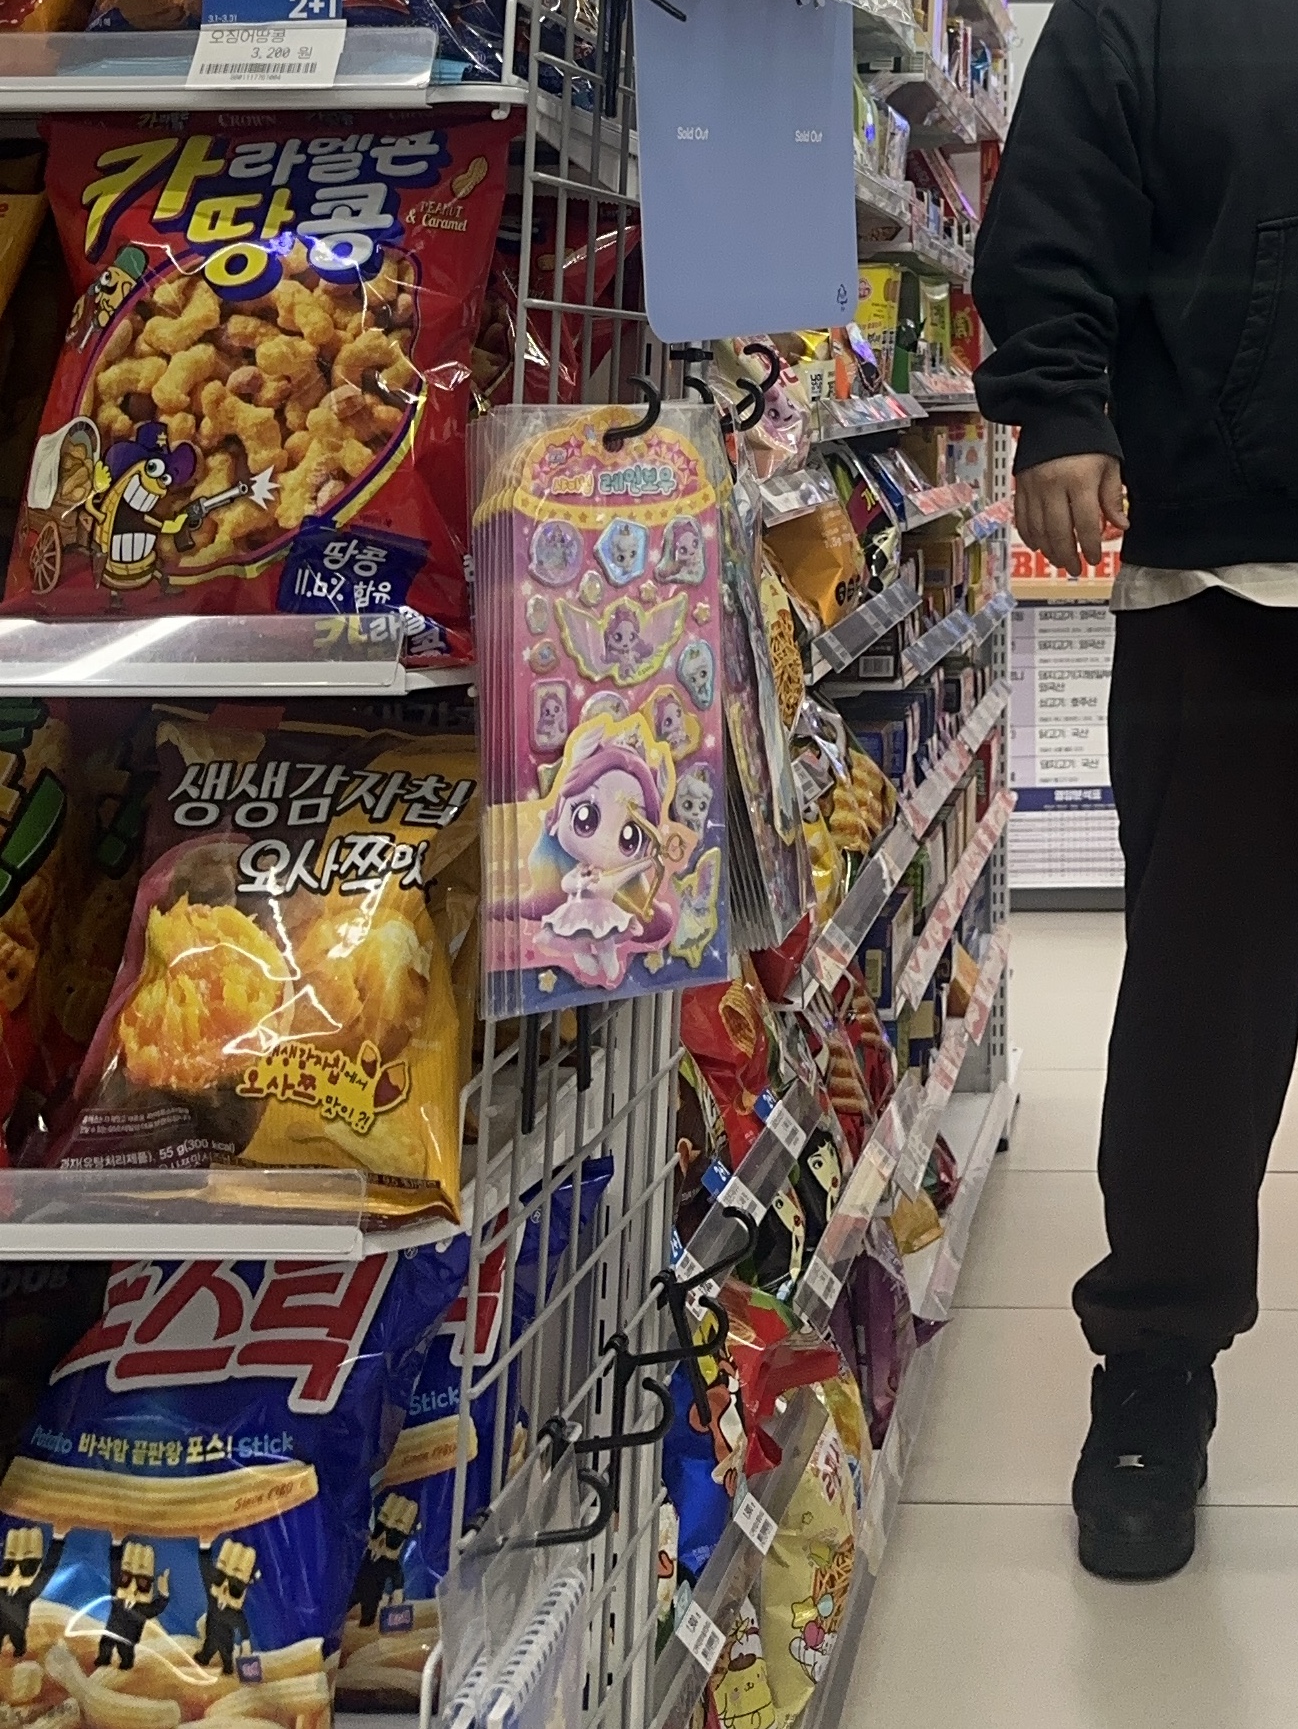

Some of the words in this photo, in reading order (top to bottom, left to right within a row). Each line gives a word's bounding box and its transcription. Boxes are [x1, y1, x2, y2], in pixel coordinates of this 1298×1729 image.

[209, 28, 287, 45] 오징어땅콩
[250, 46, 292, 60] 3,200
[297, 46, 313, 60] 원
[677, 126, 695, 141] Sold
[696, 126, 709, 141] Out
[405, 208, 417, 225] &
[421, 214, 468, 233] Caramel
[420, 200, 465, 219] PEANUT
[185, 182, 395, 288] 땅콩
[600, 464, 677, 497] 레인보우
[322, 538, 389, 578] 땅콩
[354, 579, 392, 609] 함유
[168, 758, 478, 829] 생생감자칩
[408, 1386, 462, 1417] Stick
[238, 1430, 294, 1459] Stick
